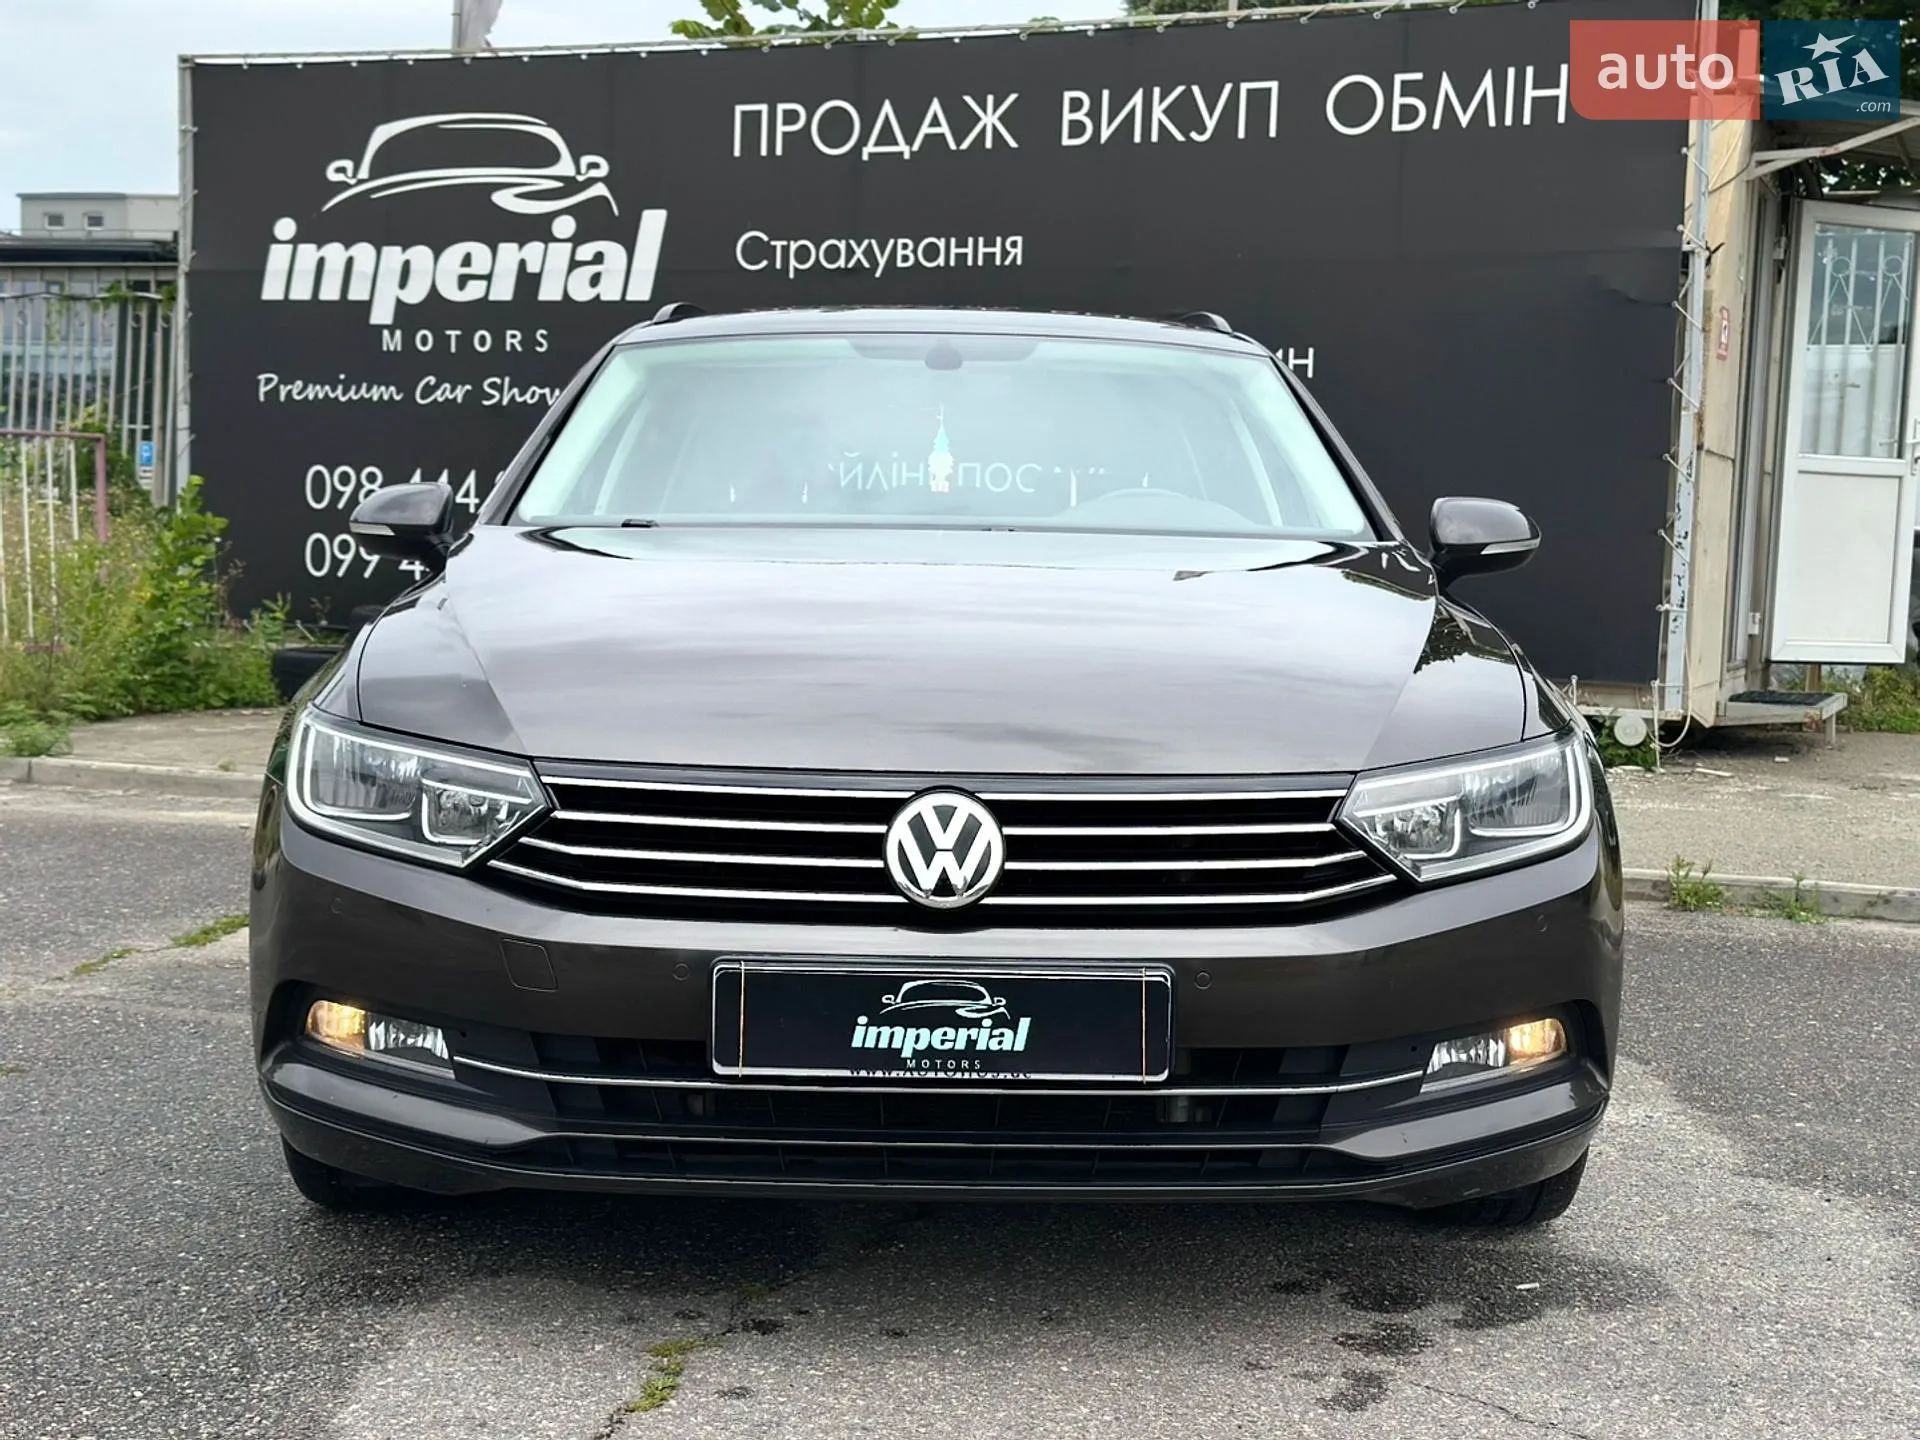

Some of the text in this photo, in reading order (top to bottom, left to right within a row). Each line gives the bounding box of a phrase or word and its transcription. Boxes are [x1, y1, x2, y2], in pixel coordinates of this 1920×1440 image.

[733, 63, 1569, 161] ПРОДАЖ ВИКУП ОБМІН
[261, 209, 668, 325] imperial
[735, 230, 1024, 279] Страхування
[381, 329, 549, 353] MOTORS
[257, 373, 404, 403] Premium
[415, 375, 472, 405] Car
[851, 1015, 1031, 1058] imperial
[906, 1059, 982, 1071] MOTORS
